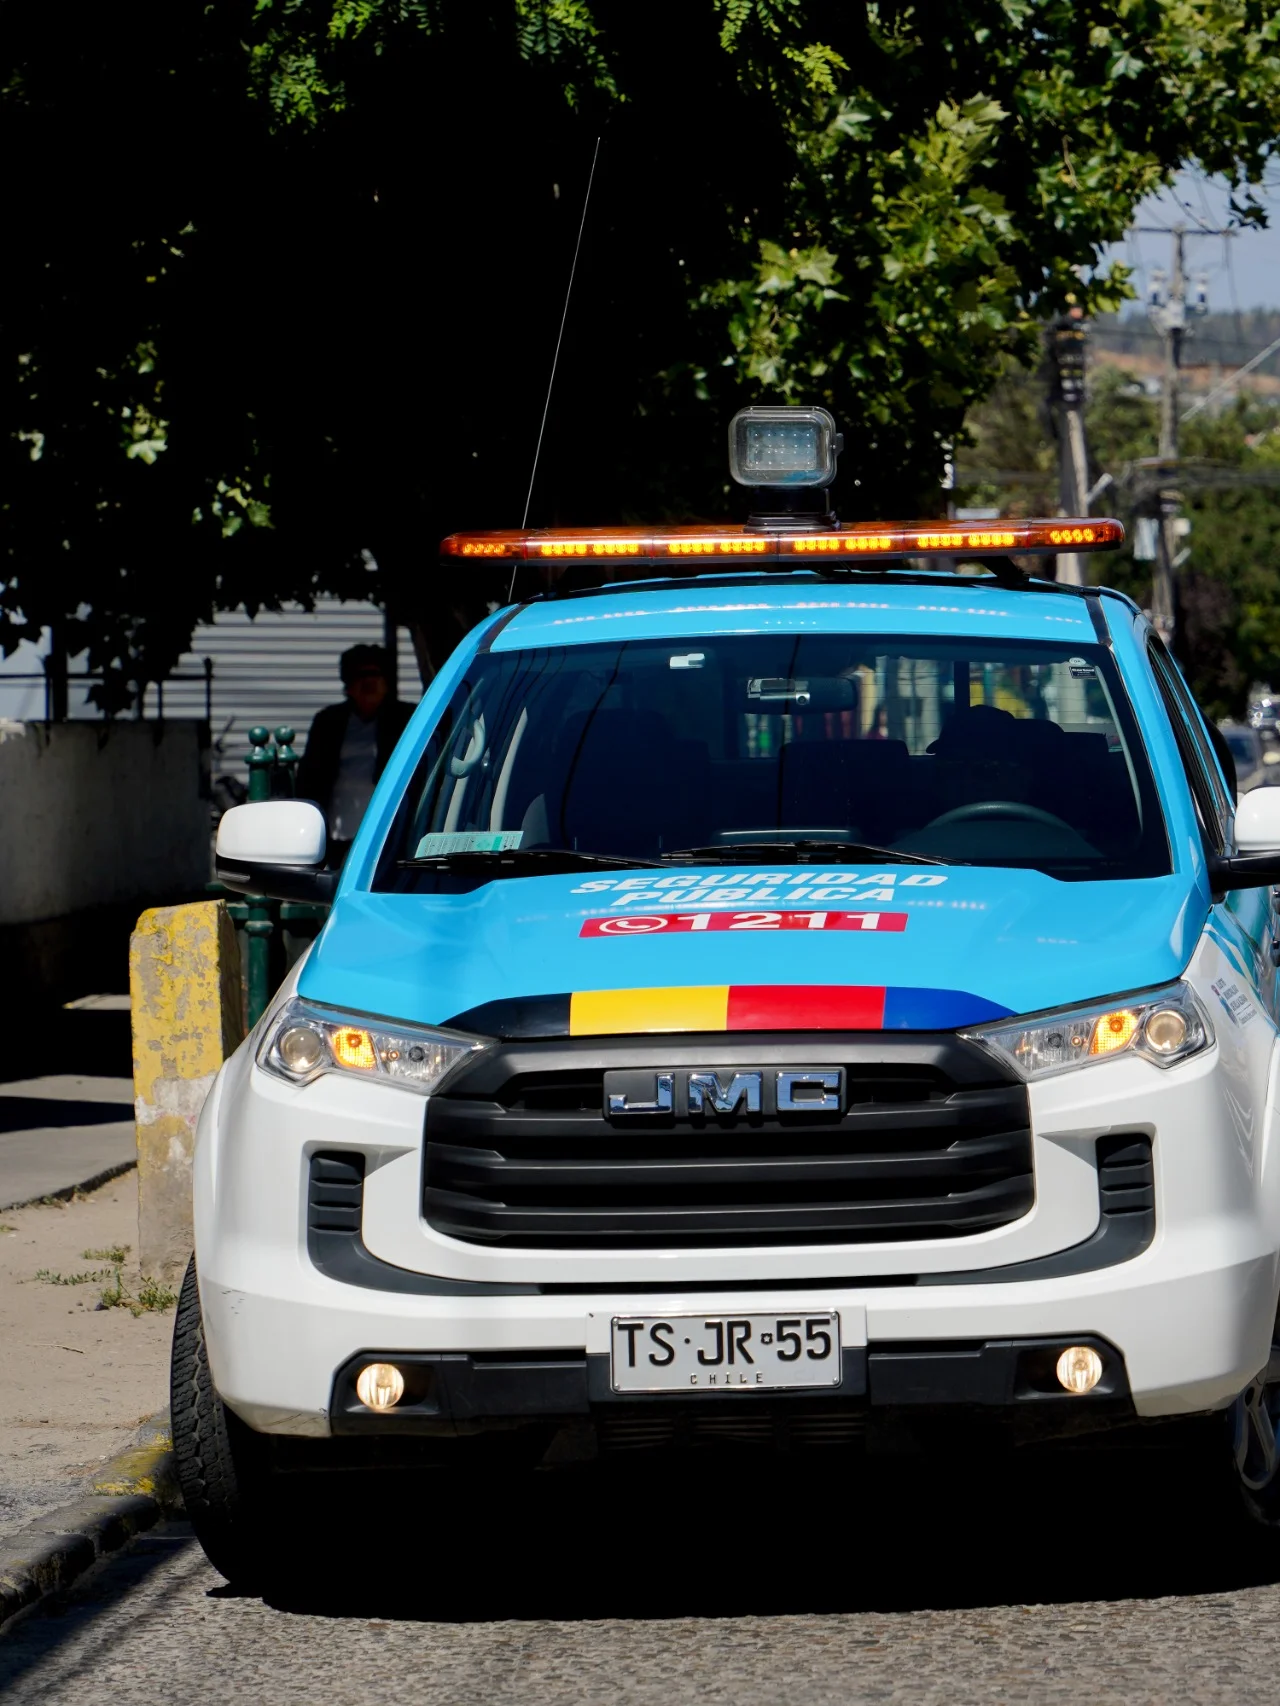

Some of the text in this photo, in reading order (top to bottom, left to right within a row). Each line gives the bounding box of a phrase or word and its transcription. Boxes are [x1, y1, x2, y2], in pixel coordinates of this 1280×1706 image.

[570, 872, 948, 894] SEGURIDAD
[610, 885, 895, 907] PÚBLICA
[676, 912, 880, 930] 1211
[608, 1071, 841, 1114] JMC
[690, 1373, 764, 1385] CHILE
